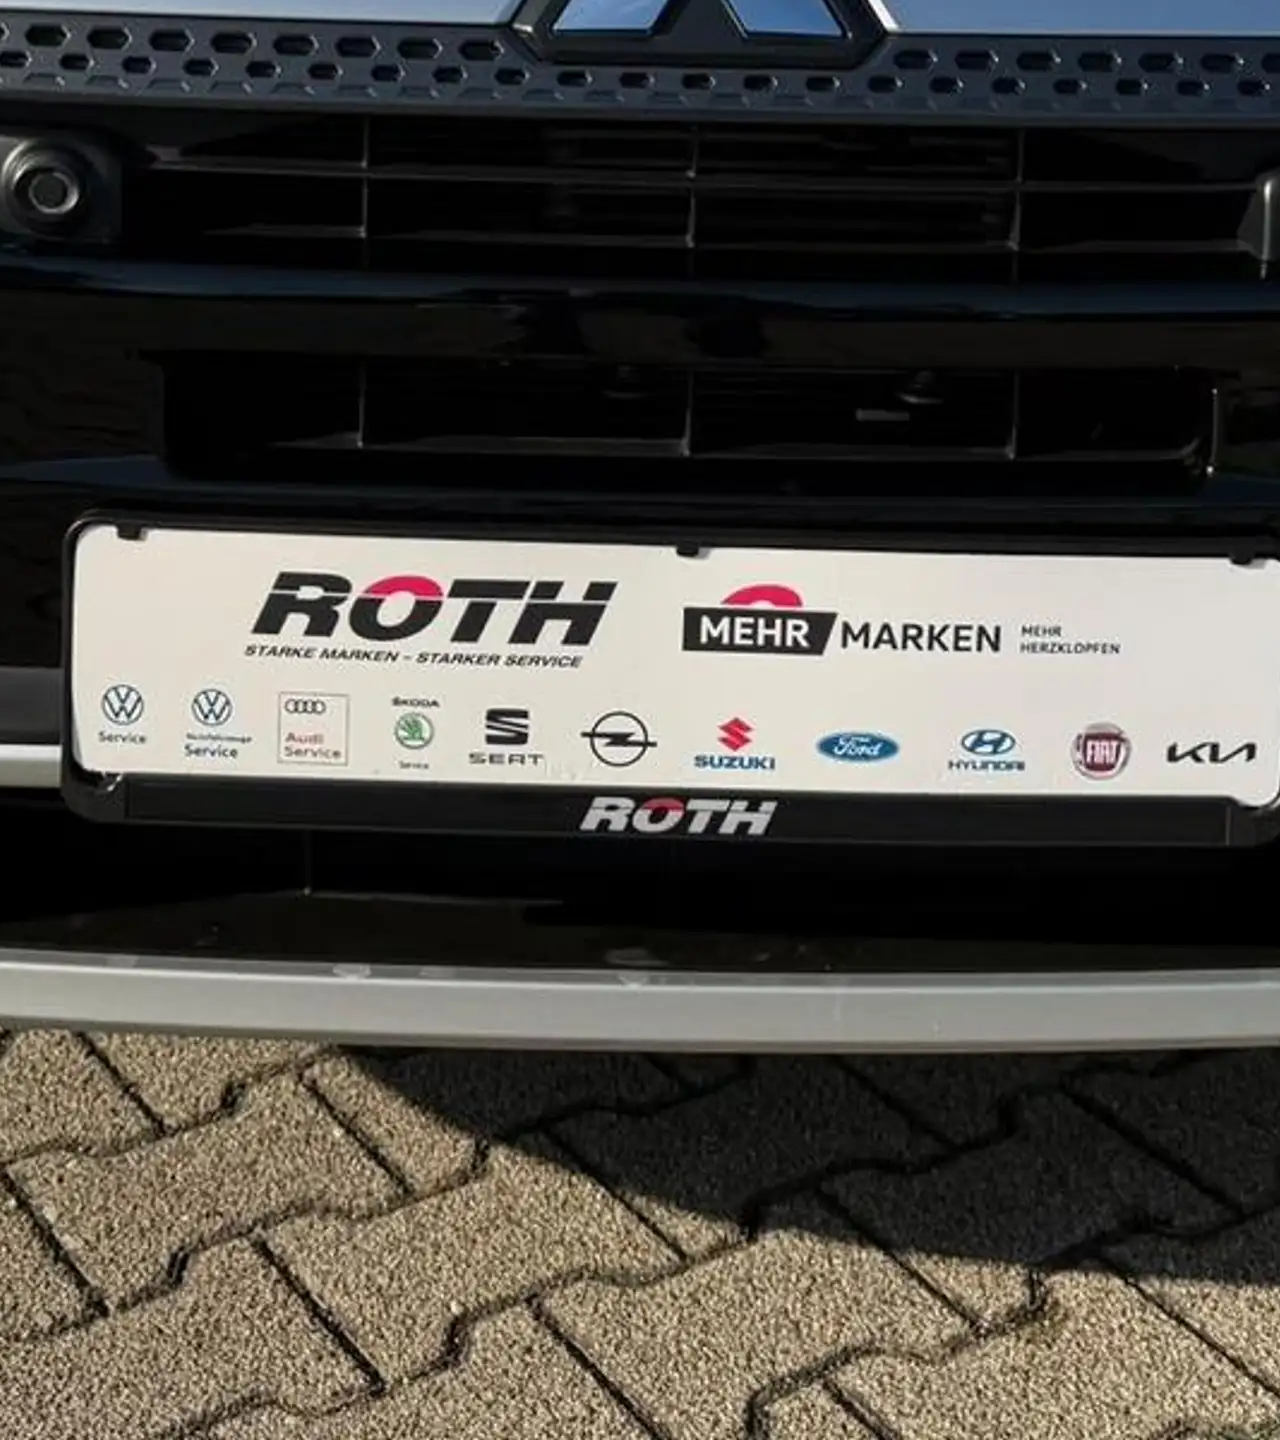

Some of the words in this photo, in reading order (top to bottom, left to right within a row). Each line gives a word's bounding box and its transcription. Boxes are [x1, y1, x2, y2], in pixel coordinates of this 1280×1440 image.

[251, 570, 618, 646] ROTH
[700, 615, 810, 647] MEHR
[841, 622, 1002, 653] MARKEN
[1021, 625, 1062, 638] MEHR
[244, 644, 315, 659] STARKE
[321, 647, 400, 662] MARKEN
[416, 651, 501, 666] STARKER
[504, 654, 583, 669] SERVICE
[1020, 642, 1121, 655] HERZKLOPFEN
[98, 731, 147, 745] Service
[284, 732, 325, 744] Audi
[832, 735, 883, 757] Ford
[184, 743, 239, 759] Service
[283, 745, 342, 760] Service
[1085, 738, 1120, 763] FIAT
[468, 753, 545, 766] SEAT
[693, 755, 776, 771] SUZUKI
[947, 759, 1026, 773] HYUNDAI
[579, 794, 779, 836] ROTH
